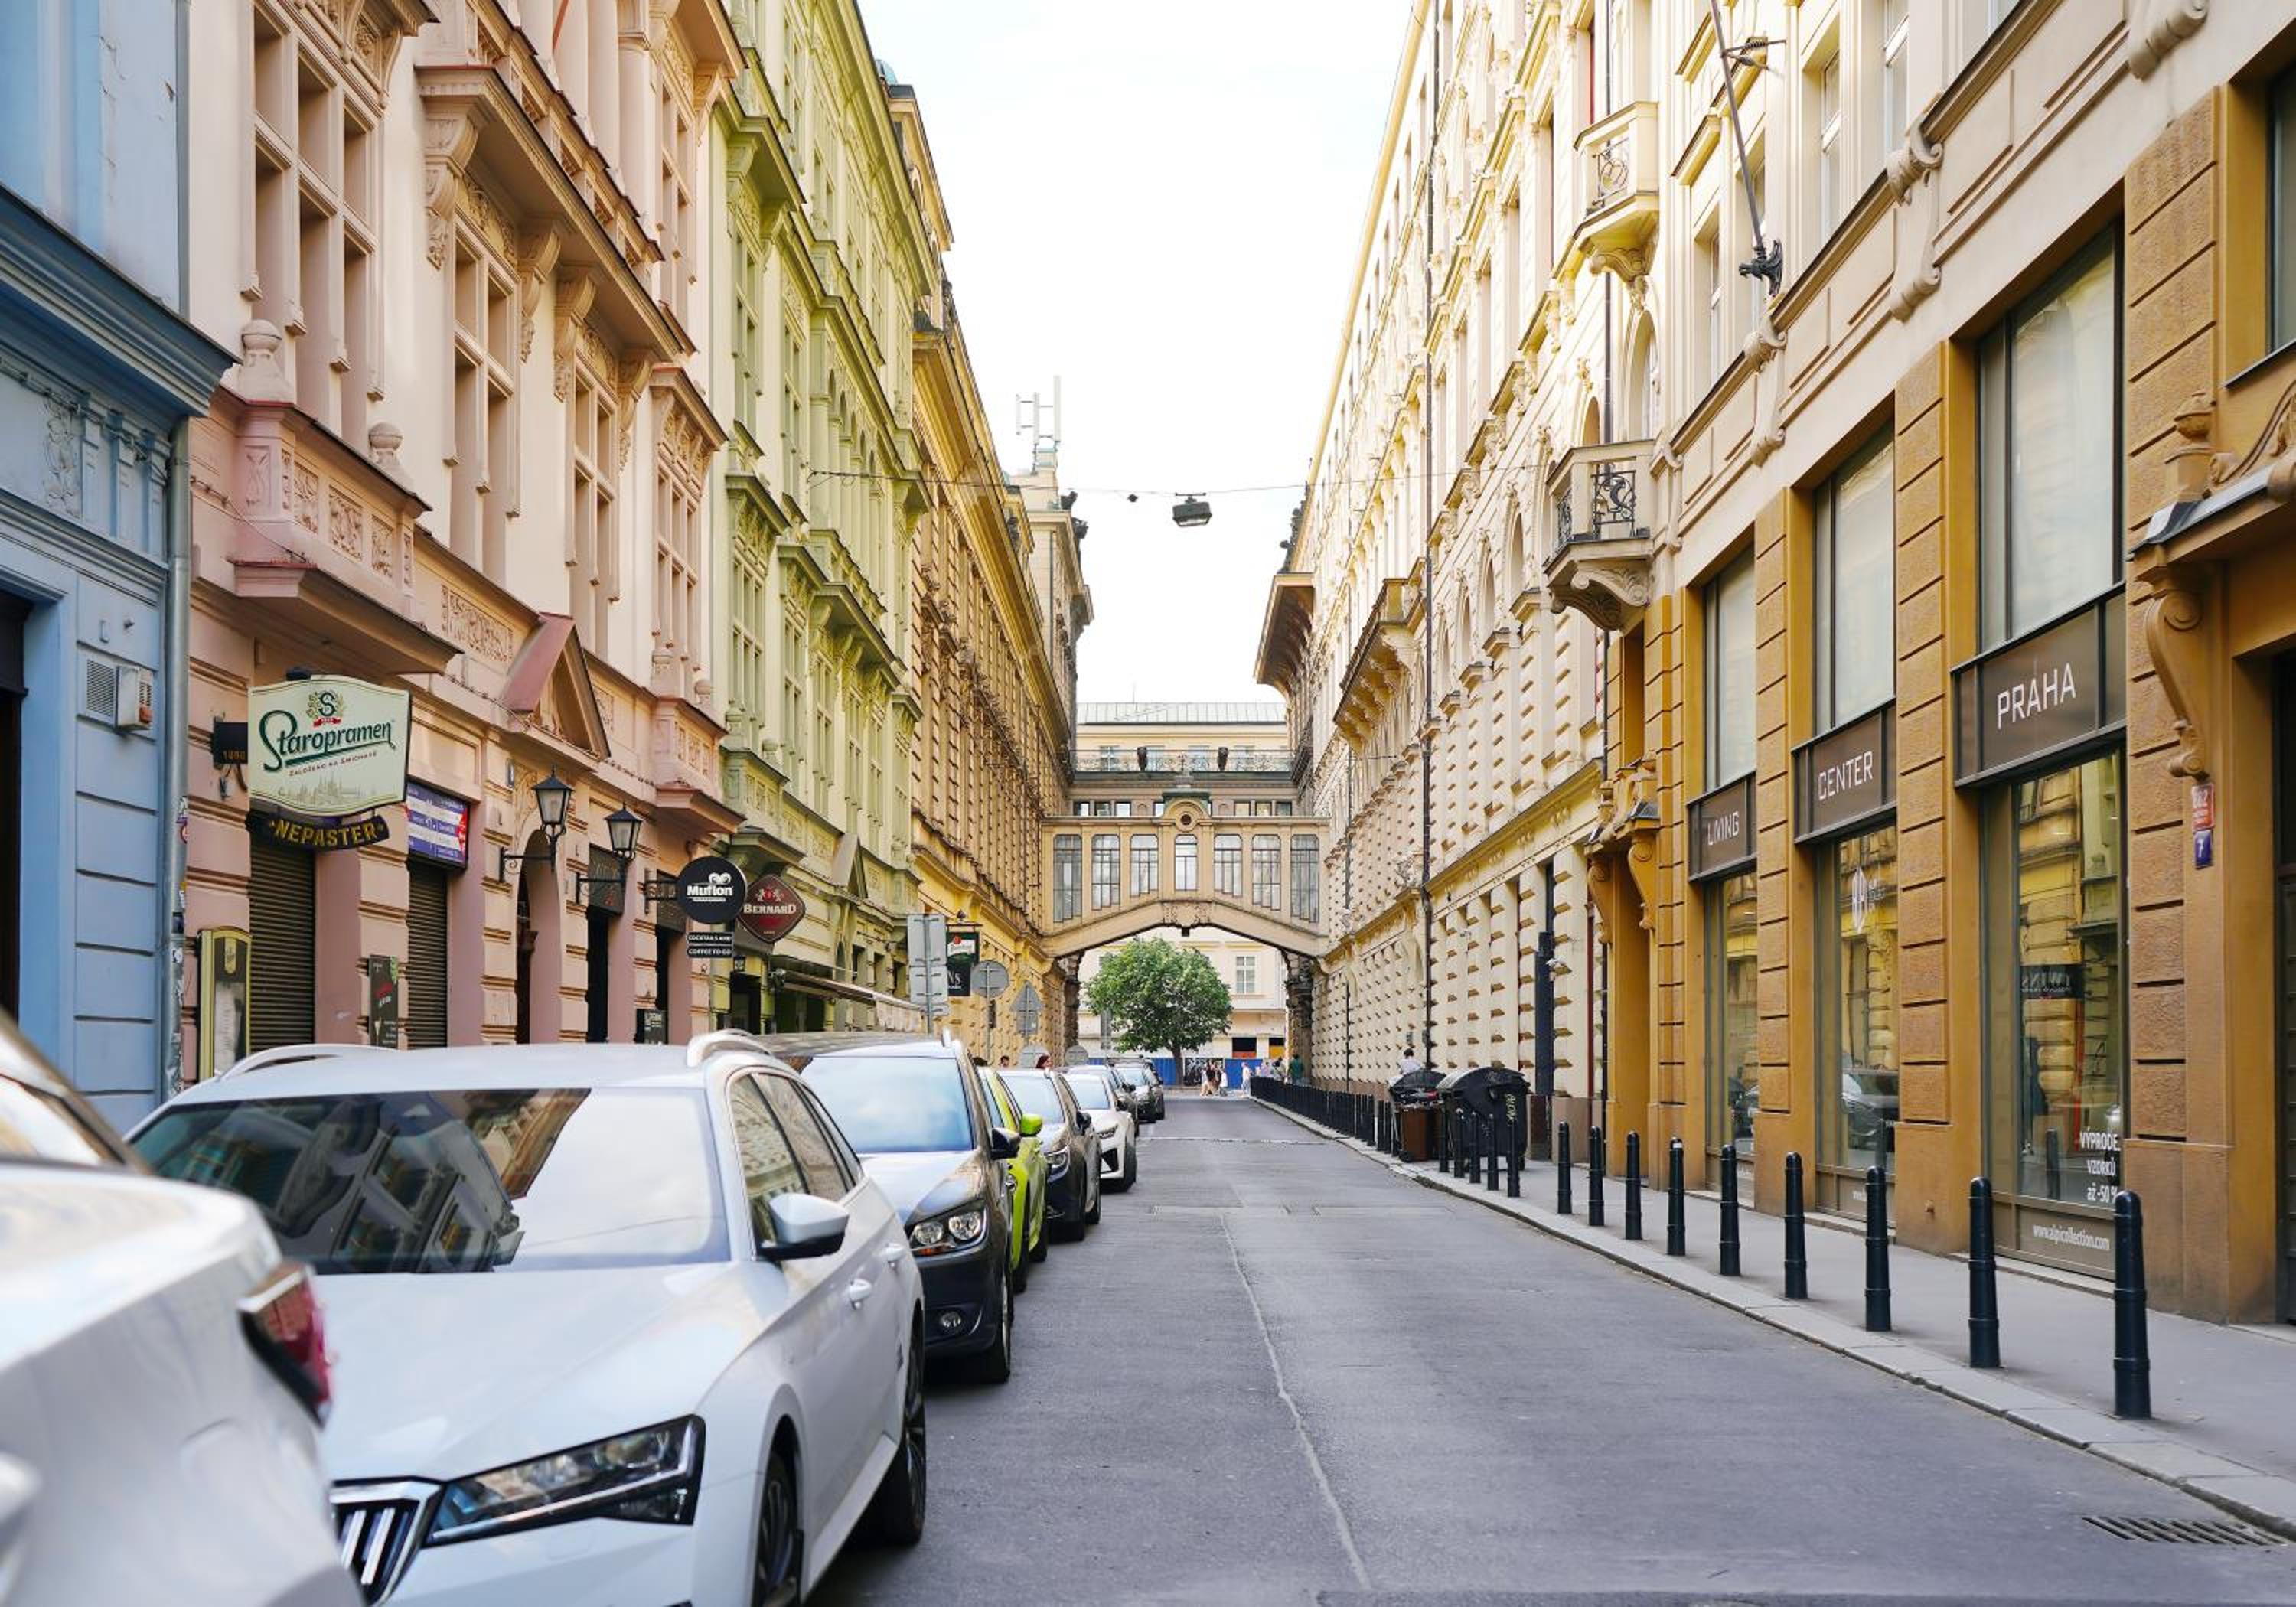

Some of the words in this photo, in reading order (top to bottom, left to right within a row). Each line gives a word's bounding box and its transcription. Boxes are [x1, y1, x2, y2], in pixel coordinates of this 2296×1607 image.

[1997, 662, 2076, 729] PRAHA
[259, 710, 396, 772] Staropramen
[1818, 751, 1874, 801] CENTER
[1707, 810, 1740, 846] LIVING
[687, 885, 733, 896] Muflon
[743, 904, 797, 914] BERNARD
[2079, 1126, 2120, 1152] VÝPRODE
